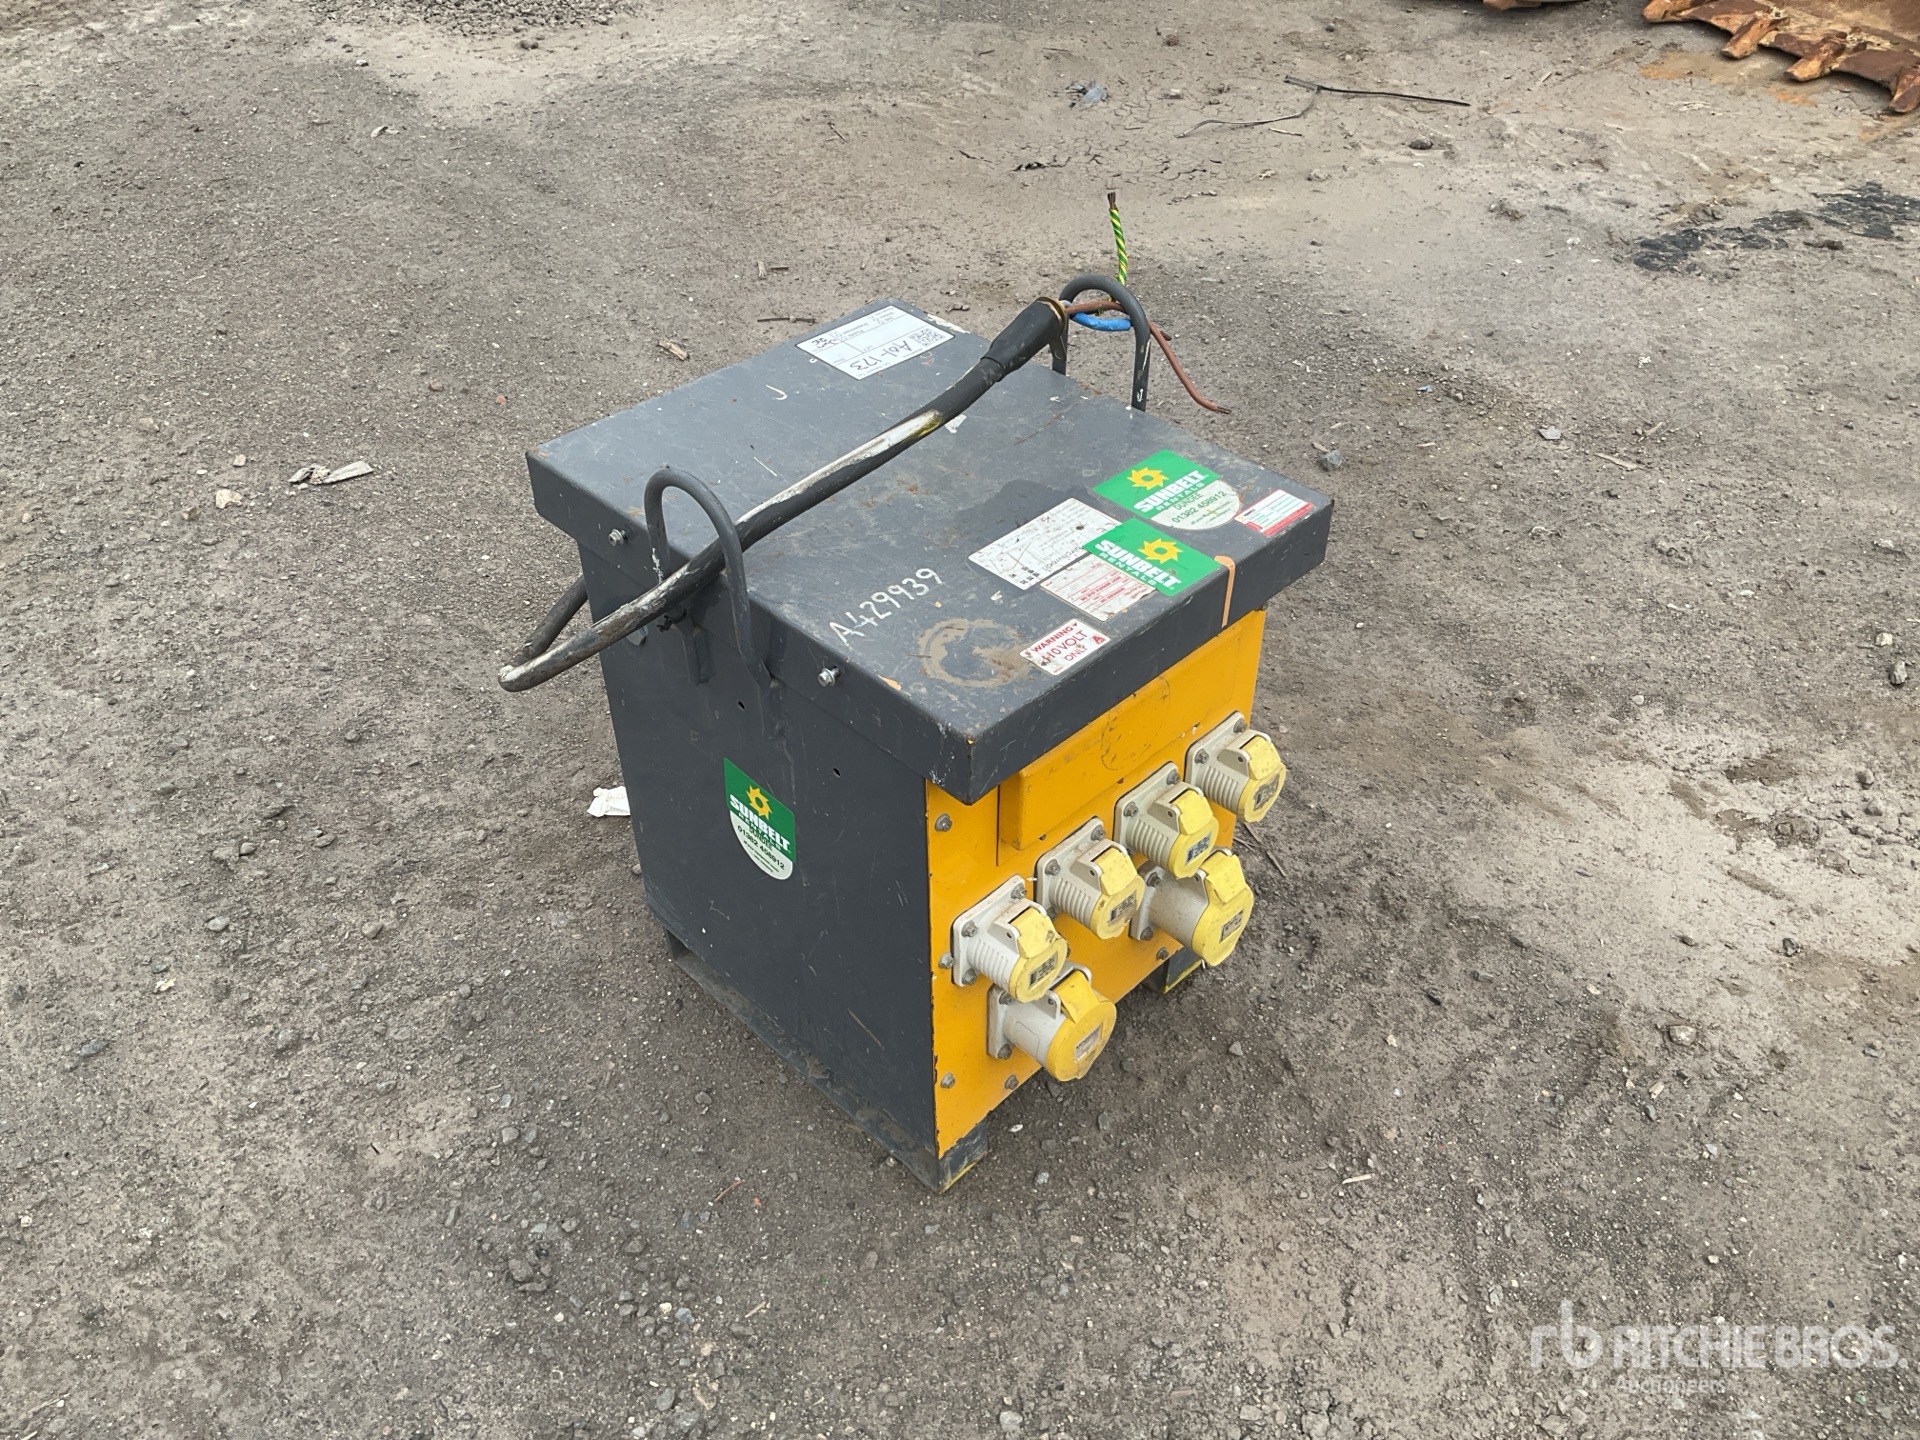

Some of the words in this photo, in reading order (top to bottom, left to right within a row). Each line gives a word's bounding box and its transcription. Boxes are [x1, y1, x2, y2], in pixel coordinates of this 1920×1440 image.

[1134, 470, 1206, 513] SUNBELT
[1156, 482, 1205, 511] RENTALS
[1174, 492, 1204, 511] DUNDEE
[1171, 506, 1198, 524] 01382
[1094, 539, 1182, 590] SUNBELT
[1099, 552, 1157, 586] RENTALS
[829, 568, 942, 650] A429939
[1031, 626, 1074, 652] WARNING
[1064, 645, 1088, 661] ONLY
[730, 794, 790, 852] SUNBELT
